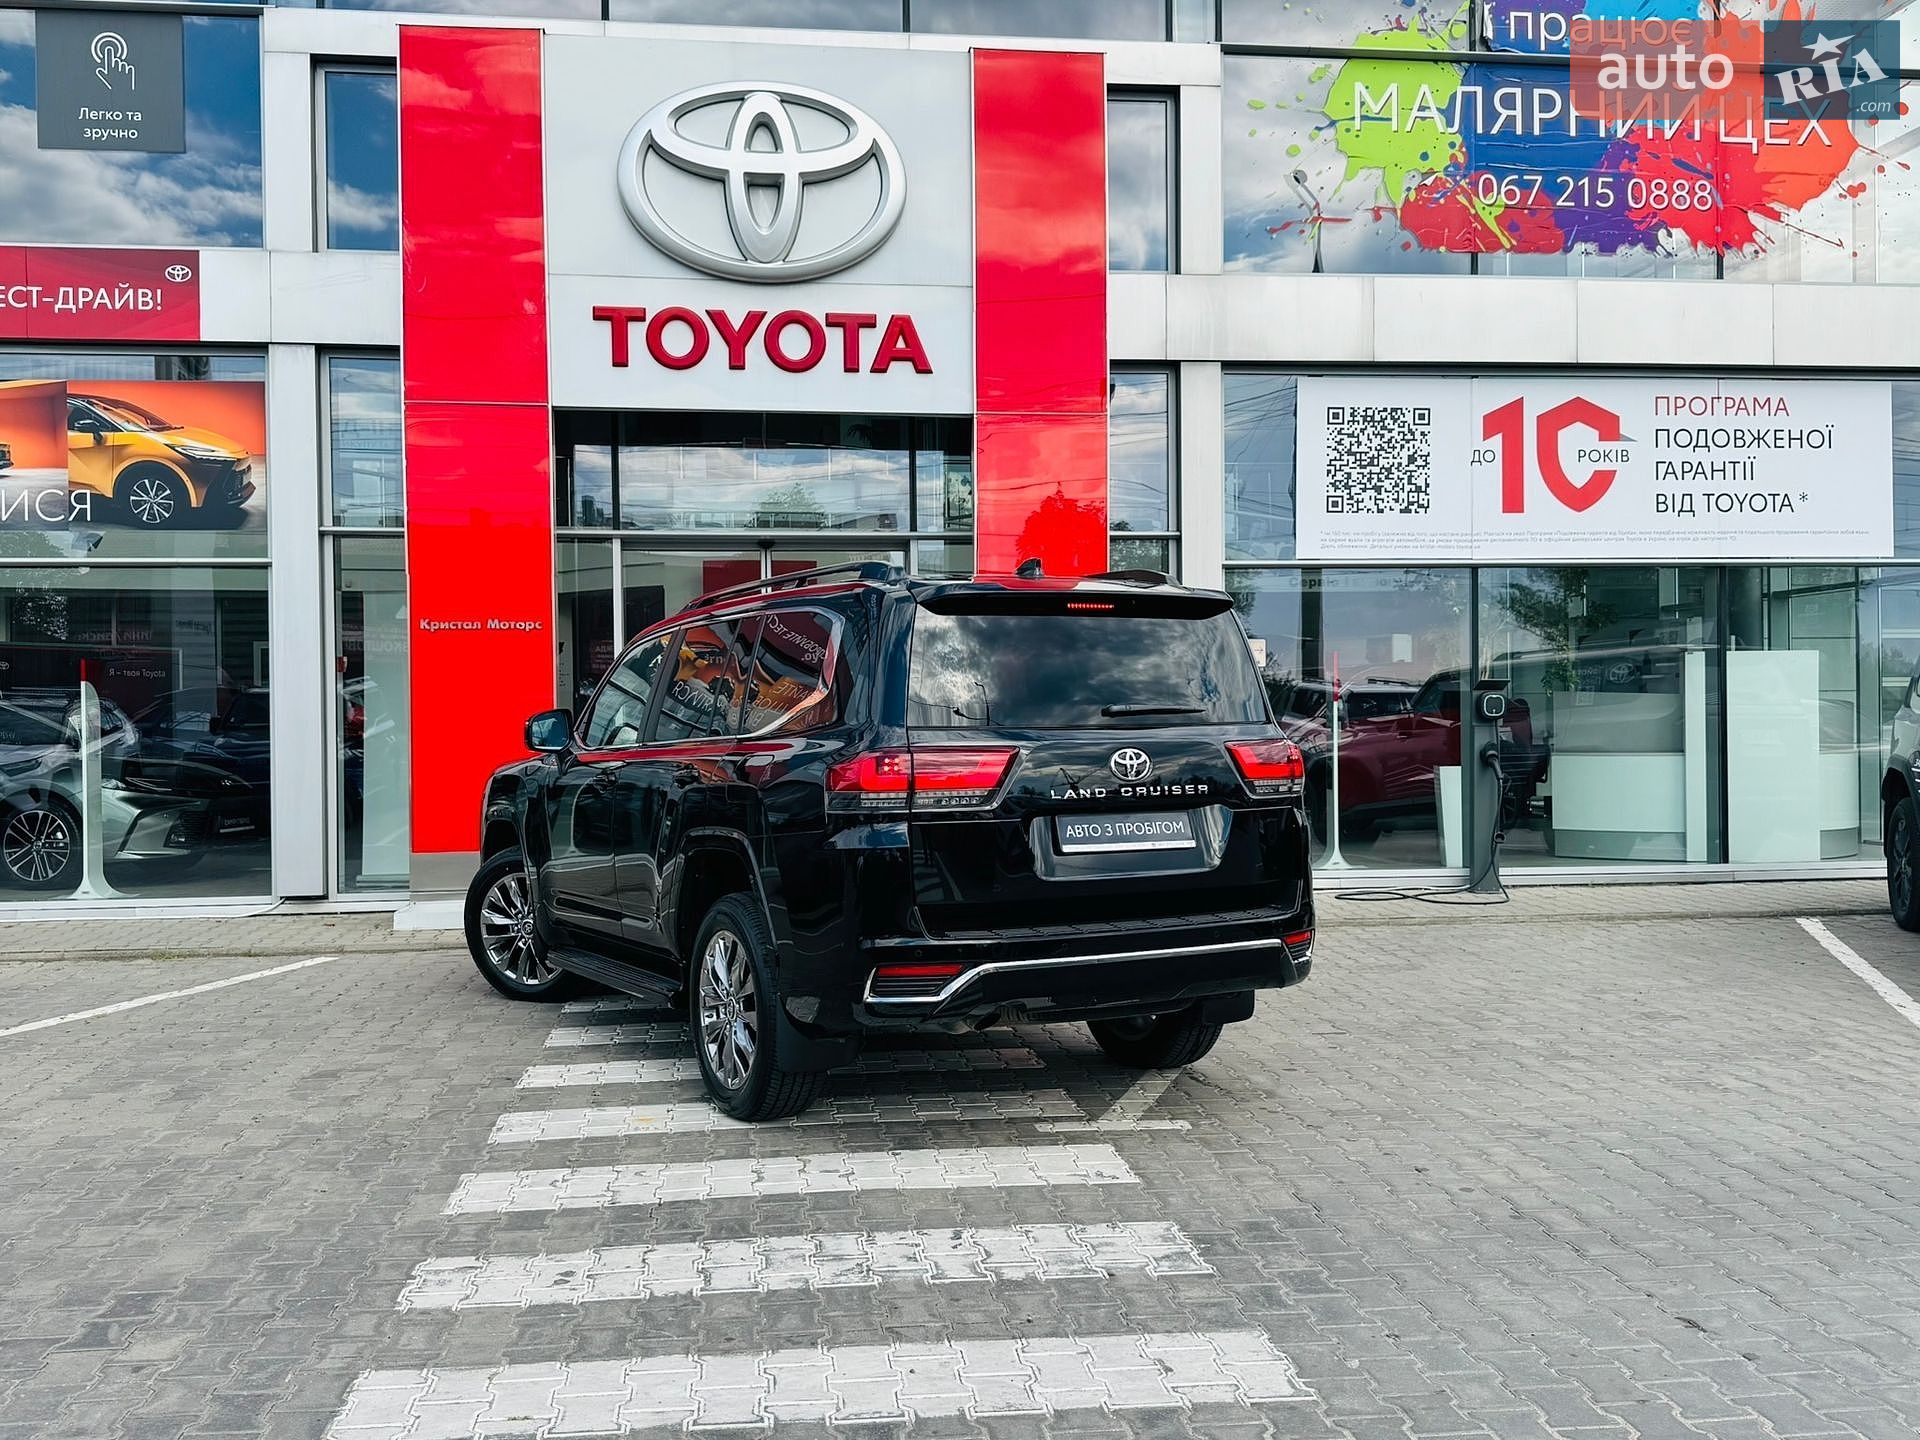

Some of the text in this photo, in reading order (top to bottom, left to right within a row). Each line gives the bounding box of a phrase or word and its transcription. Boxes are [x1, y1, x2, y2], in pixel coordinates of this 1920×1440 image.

[1509, 11, 1695, 50] працює
[78, 107, 142, 121] Легко та
[1719, 95, 1832, 154] ЦЕХ
[83, 128, 138, 140] зручно
[1478, 174, 1713, 210] 067 215 0888
[592, 305, 933, 374] TOYOTA
[1654, 395, 1790, 417] ПРОГРАМА
[1654, 424, 1835, 453] ПОДОВЖЕНОЇ
[1470, 449, 1496, 466] ДО
[1577, 449, 1630, 463] РОКІВ
[1654, 456, 1757, 481] ГАРАНТІЇ
[1655, 493, 1696, 517] ВІД
[420, 619, 543, 632] Кристал Моторс
[142, 668, 166, 679] Toyota
[1050, 784, 1209, 800] LAND CRUISER
[1066, 823, 1101, 838] АВТО
[1116, 821, 1185, 836] ПРОБІГОМ
